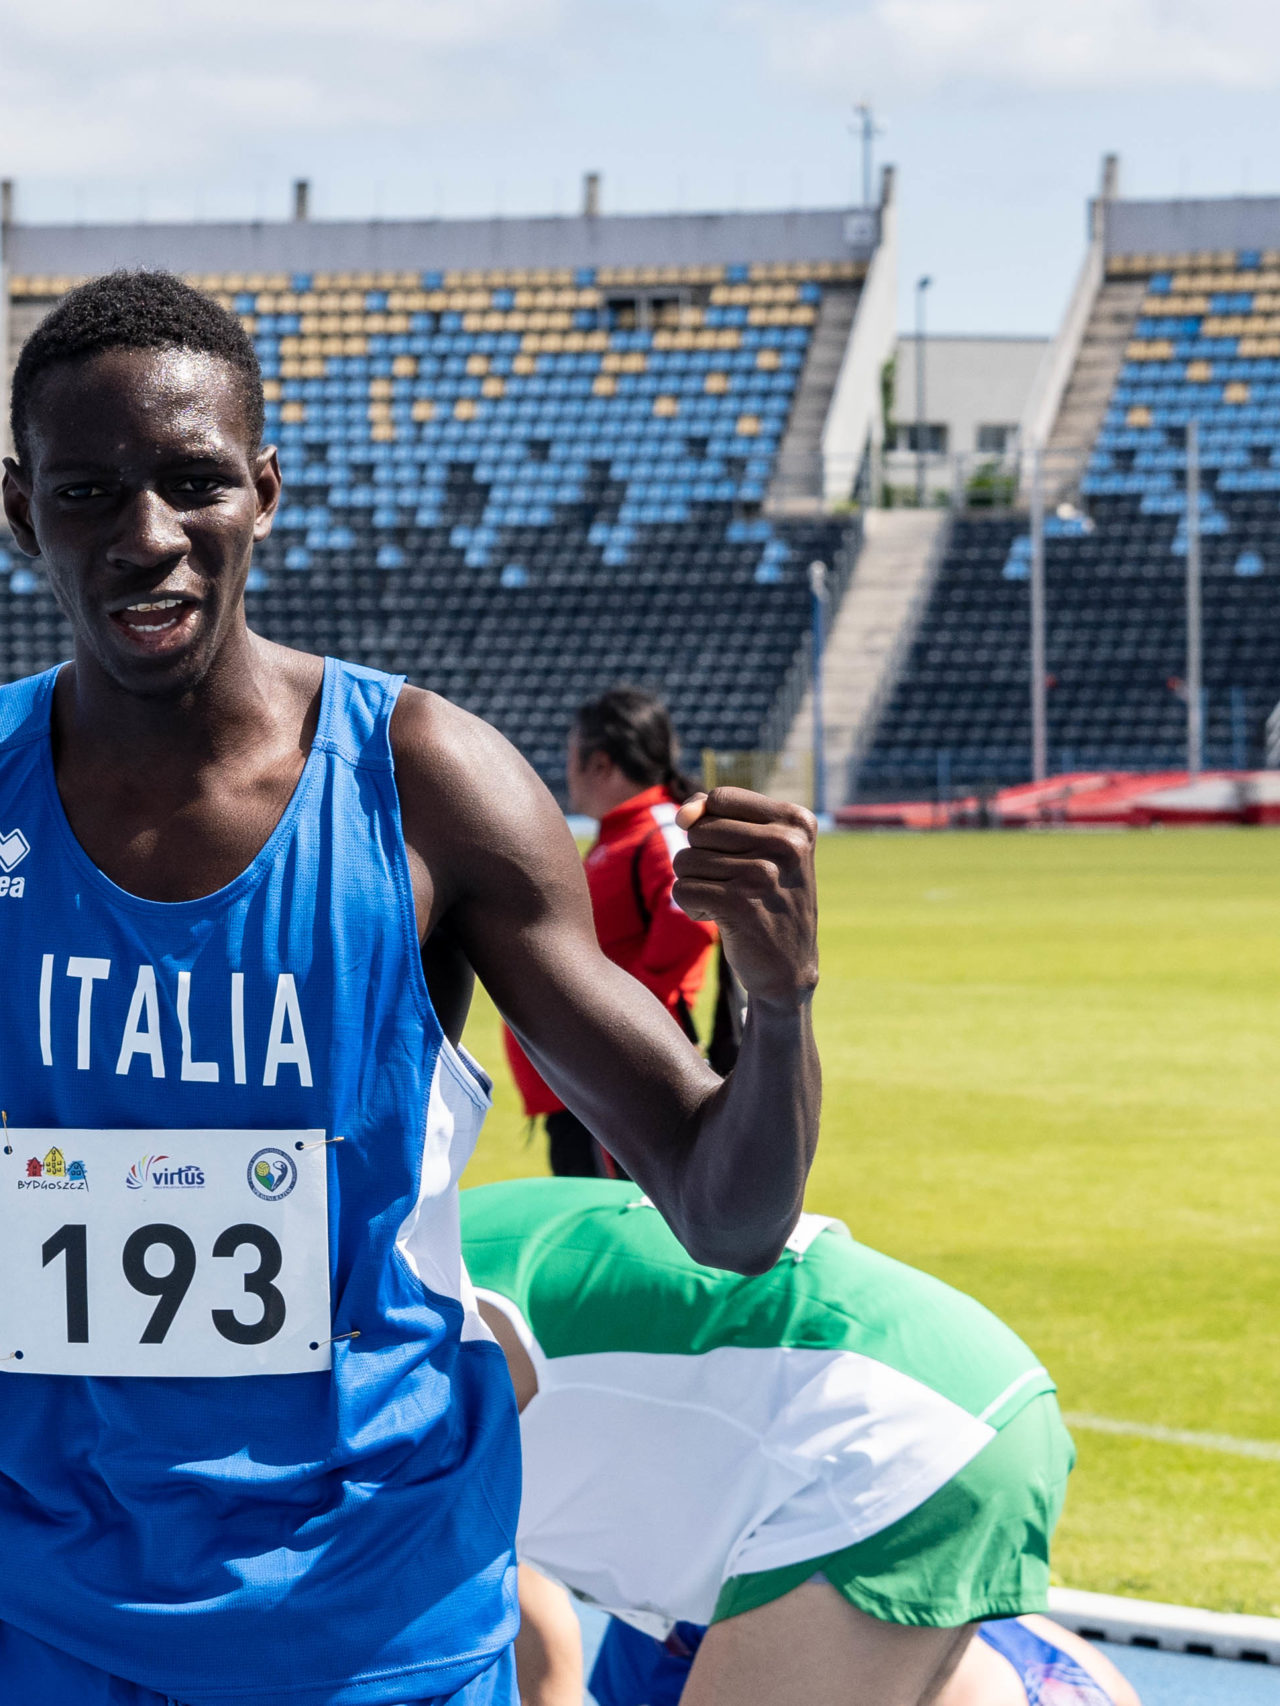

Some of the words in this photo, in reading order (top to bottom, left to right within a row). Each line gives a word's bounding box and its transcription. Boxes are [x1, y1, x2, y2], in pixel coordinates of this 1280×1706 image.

[39, 953, 314, 1087] ITALIA
[17, 1179, 87, 1191] BYDGOSZCZ
[152, 1166, 205, 1186] virtus
[41, 1223, 287, 1346] 193
